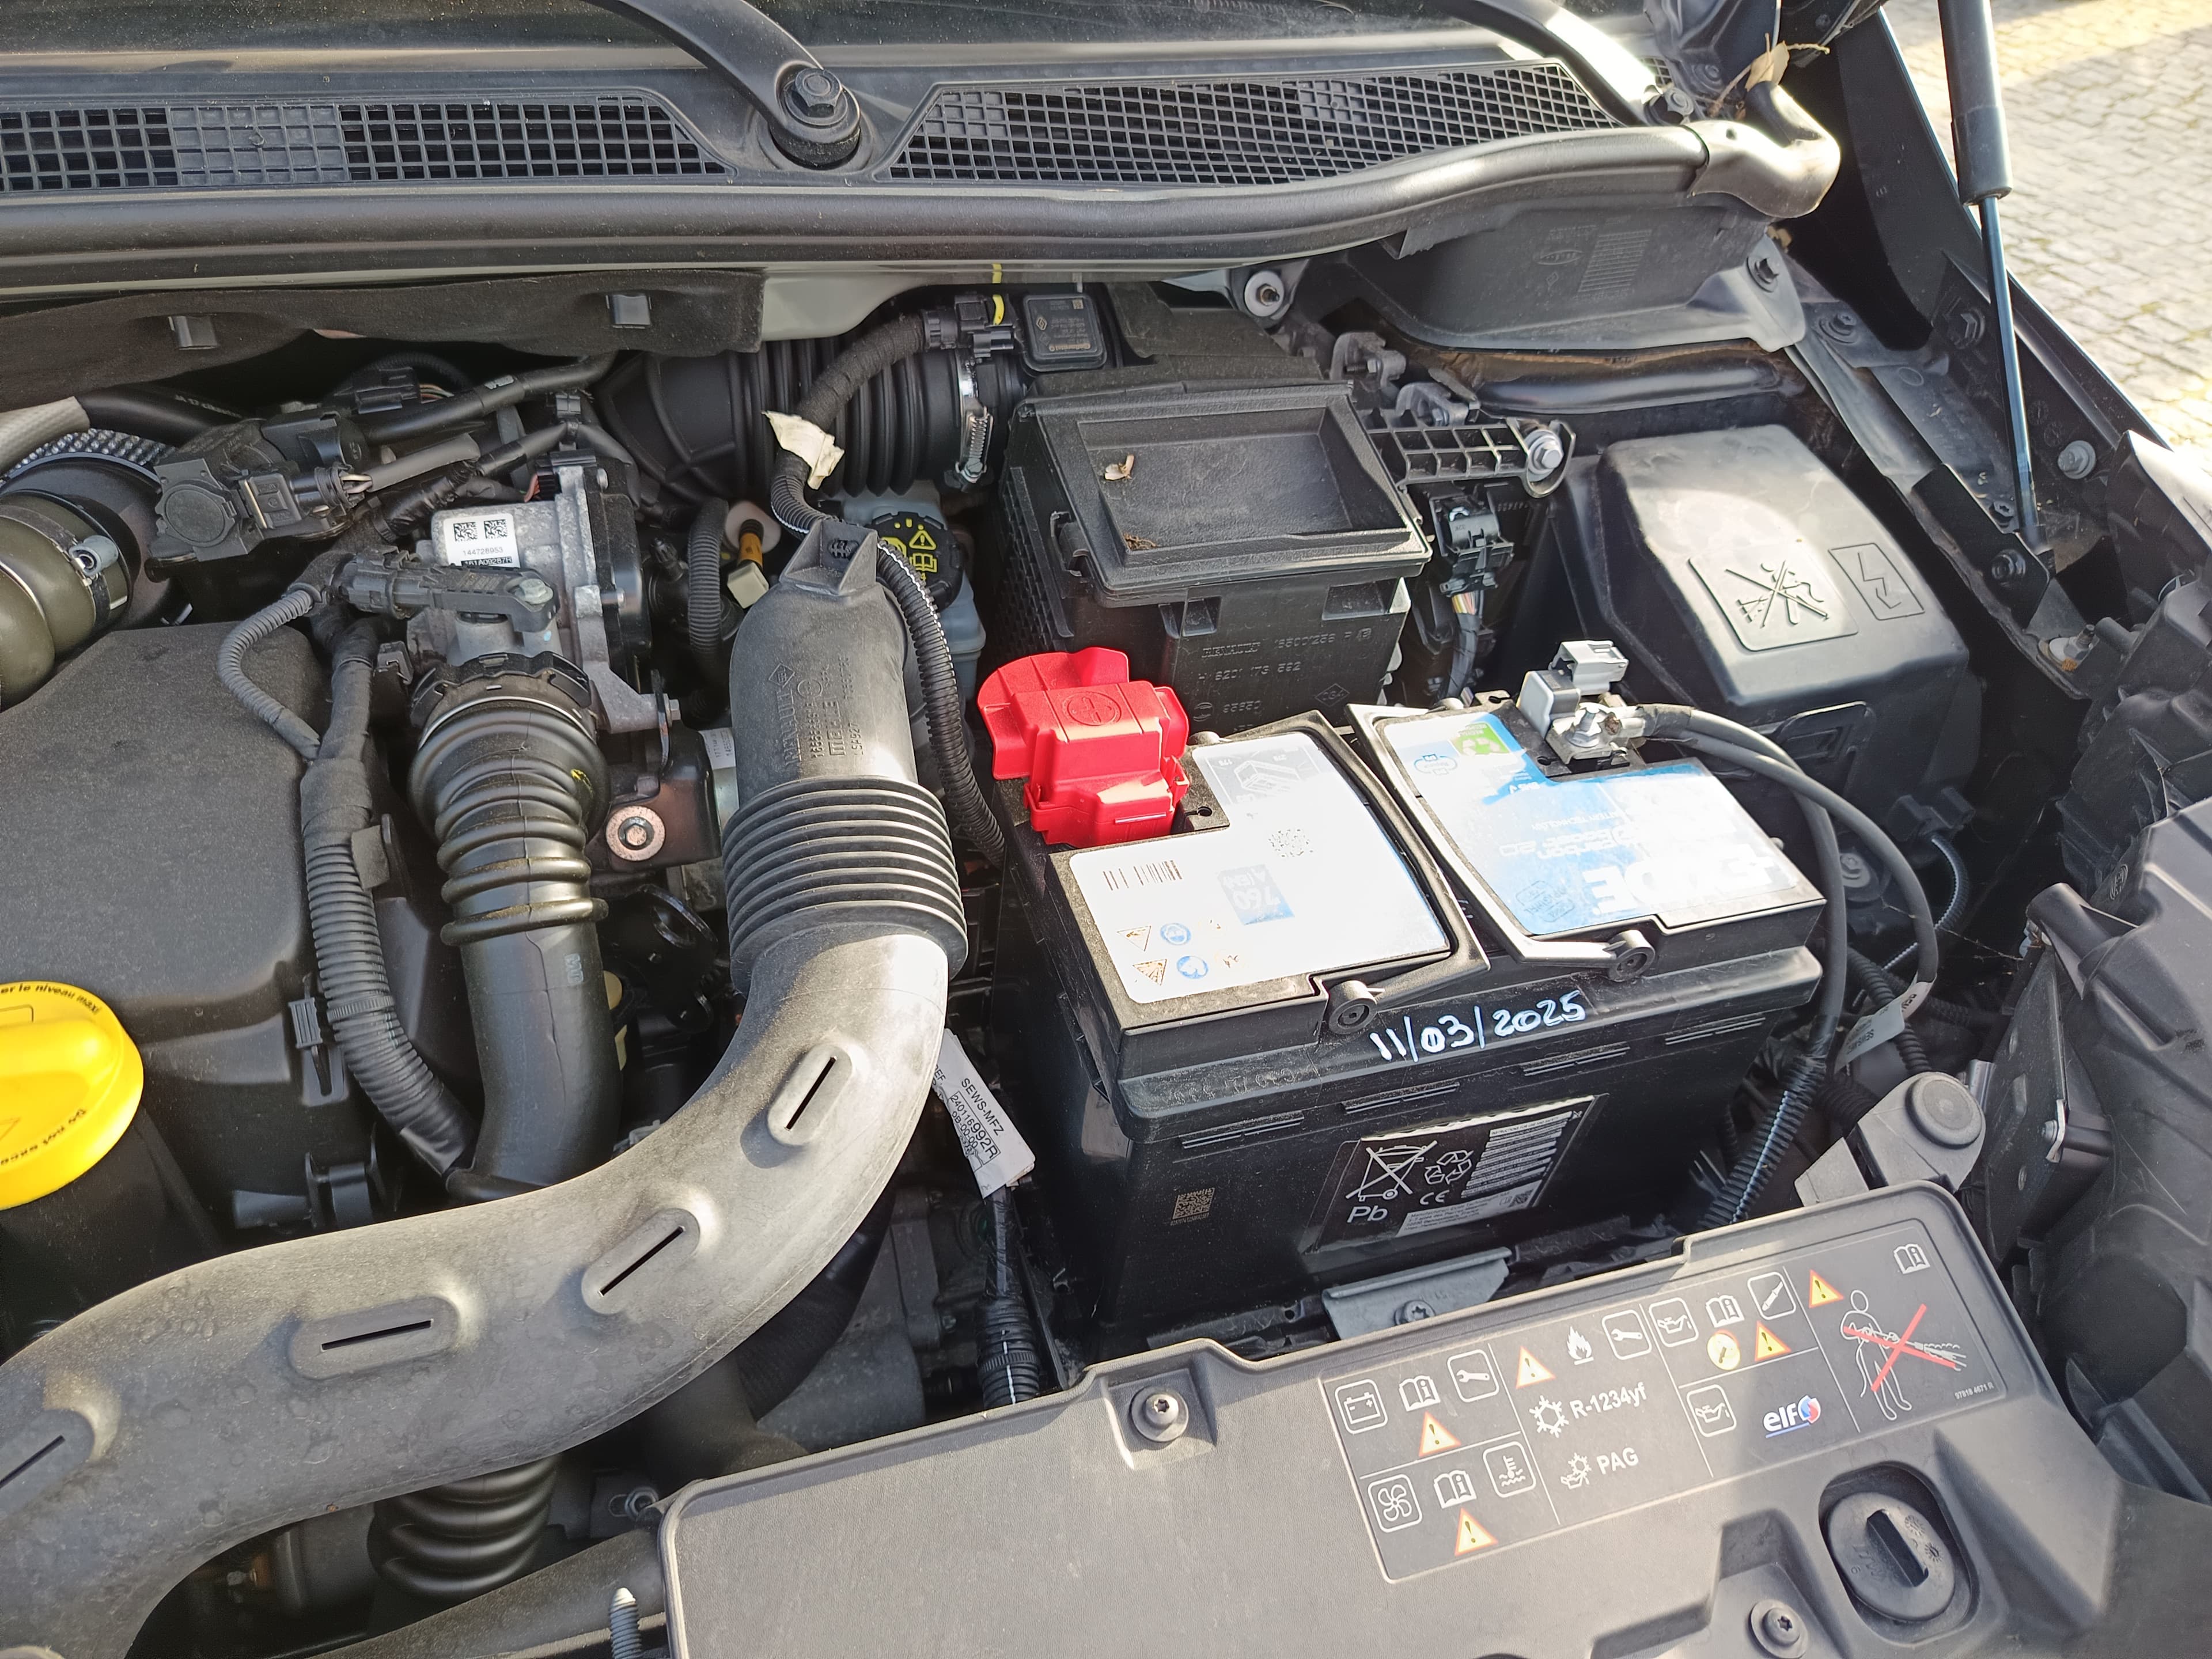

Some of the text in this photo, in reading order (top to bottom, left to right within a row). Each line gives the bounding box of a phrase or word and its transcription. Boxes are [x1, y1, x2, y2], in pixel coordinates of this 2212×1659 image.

[463, 547, 503, 555] 144728953
[36, 983, 75, 999] niveau
[1369, 990, 1586, 1063] 11/03/2025
[961, 1078, 1005, 1137] SEWS-MFZ
[951, 1094, 998, 1160] 240116992R
[1347, 1205, 1388, 1223] Pb
[1569, 1382, 1648, 1419] R-1234yf
[1987, 1382, 1994, 1390] R
[1763, 1402, 1799, 1432] elf
[1596, 1447, 1639, 1475] PAG
